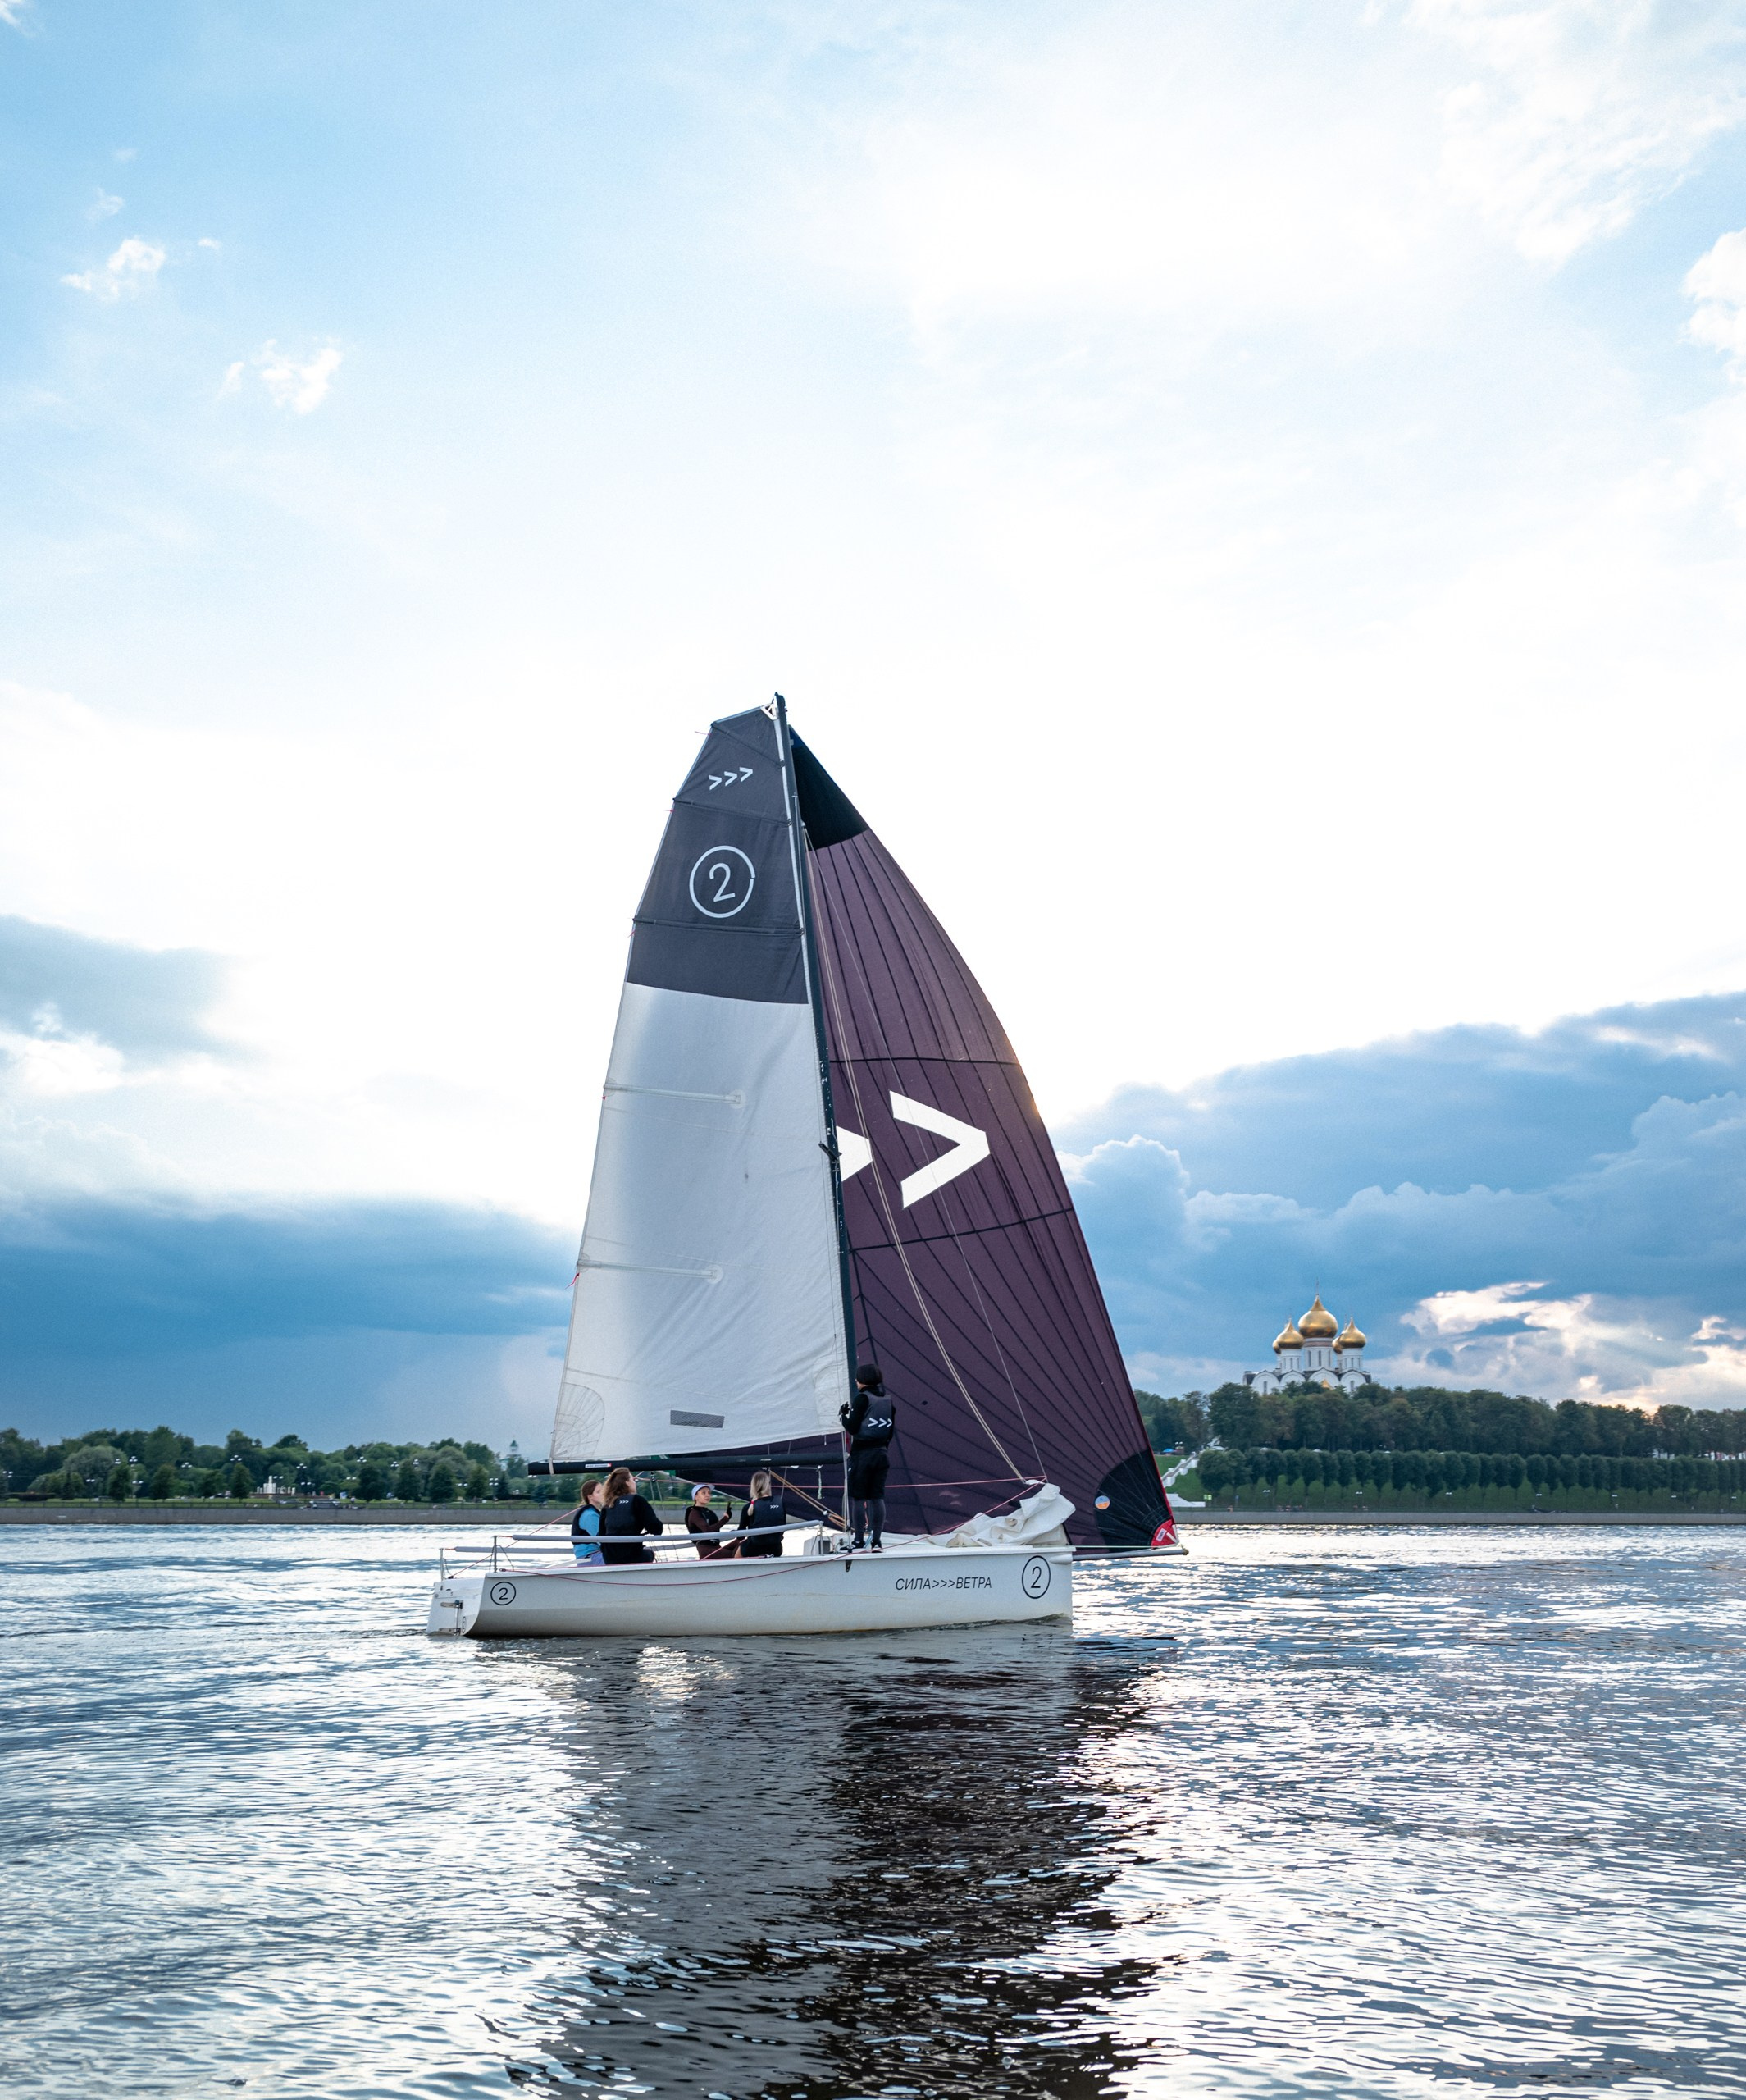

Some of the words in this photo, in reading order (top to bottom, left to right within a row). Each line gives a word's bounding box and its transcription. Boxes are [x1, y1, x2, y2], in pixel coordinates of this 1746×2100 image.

[709, 862, 736, 902] 2
[1031, 1566, 1042, 1589] 2
[498, 1587, 509, 1600] 2
